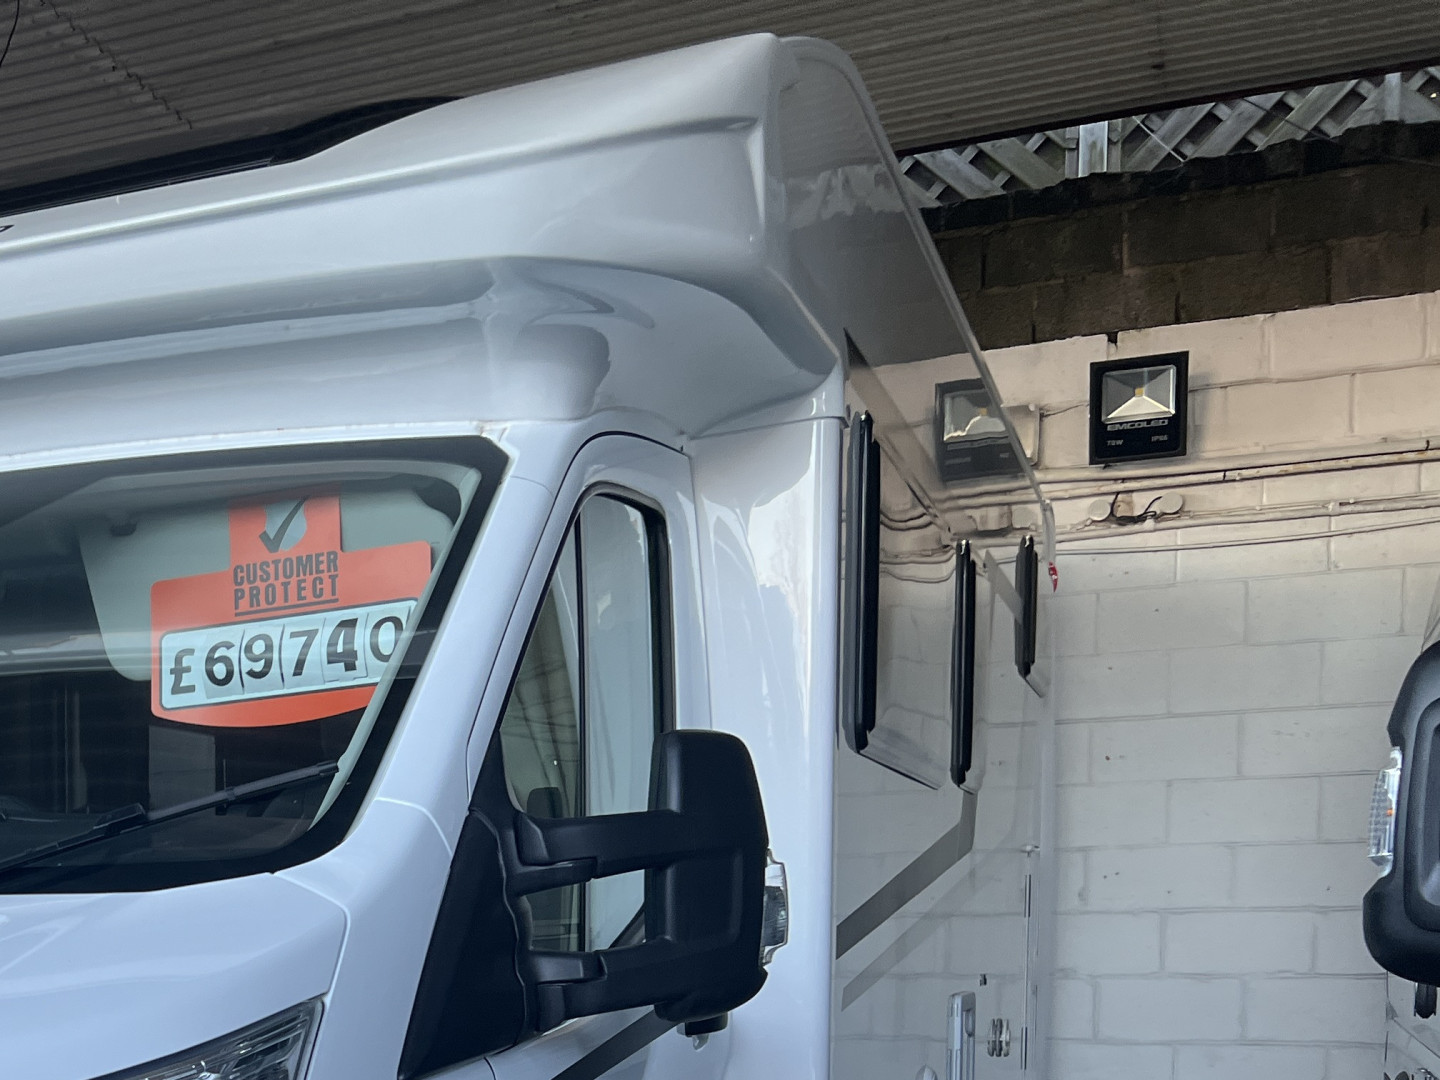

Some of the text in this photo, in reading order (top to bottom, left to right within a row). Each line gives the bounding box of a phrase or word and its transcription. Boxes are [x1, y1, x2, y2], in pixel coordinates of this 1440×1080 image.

[233, 550, 339, 586] CUSTOMER
[233, 573, 339, 610] PROTECT
[169, 615, 406, 695] £69740
